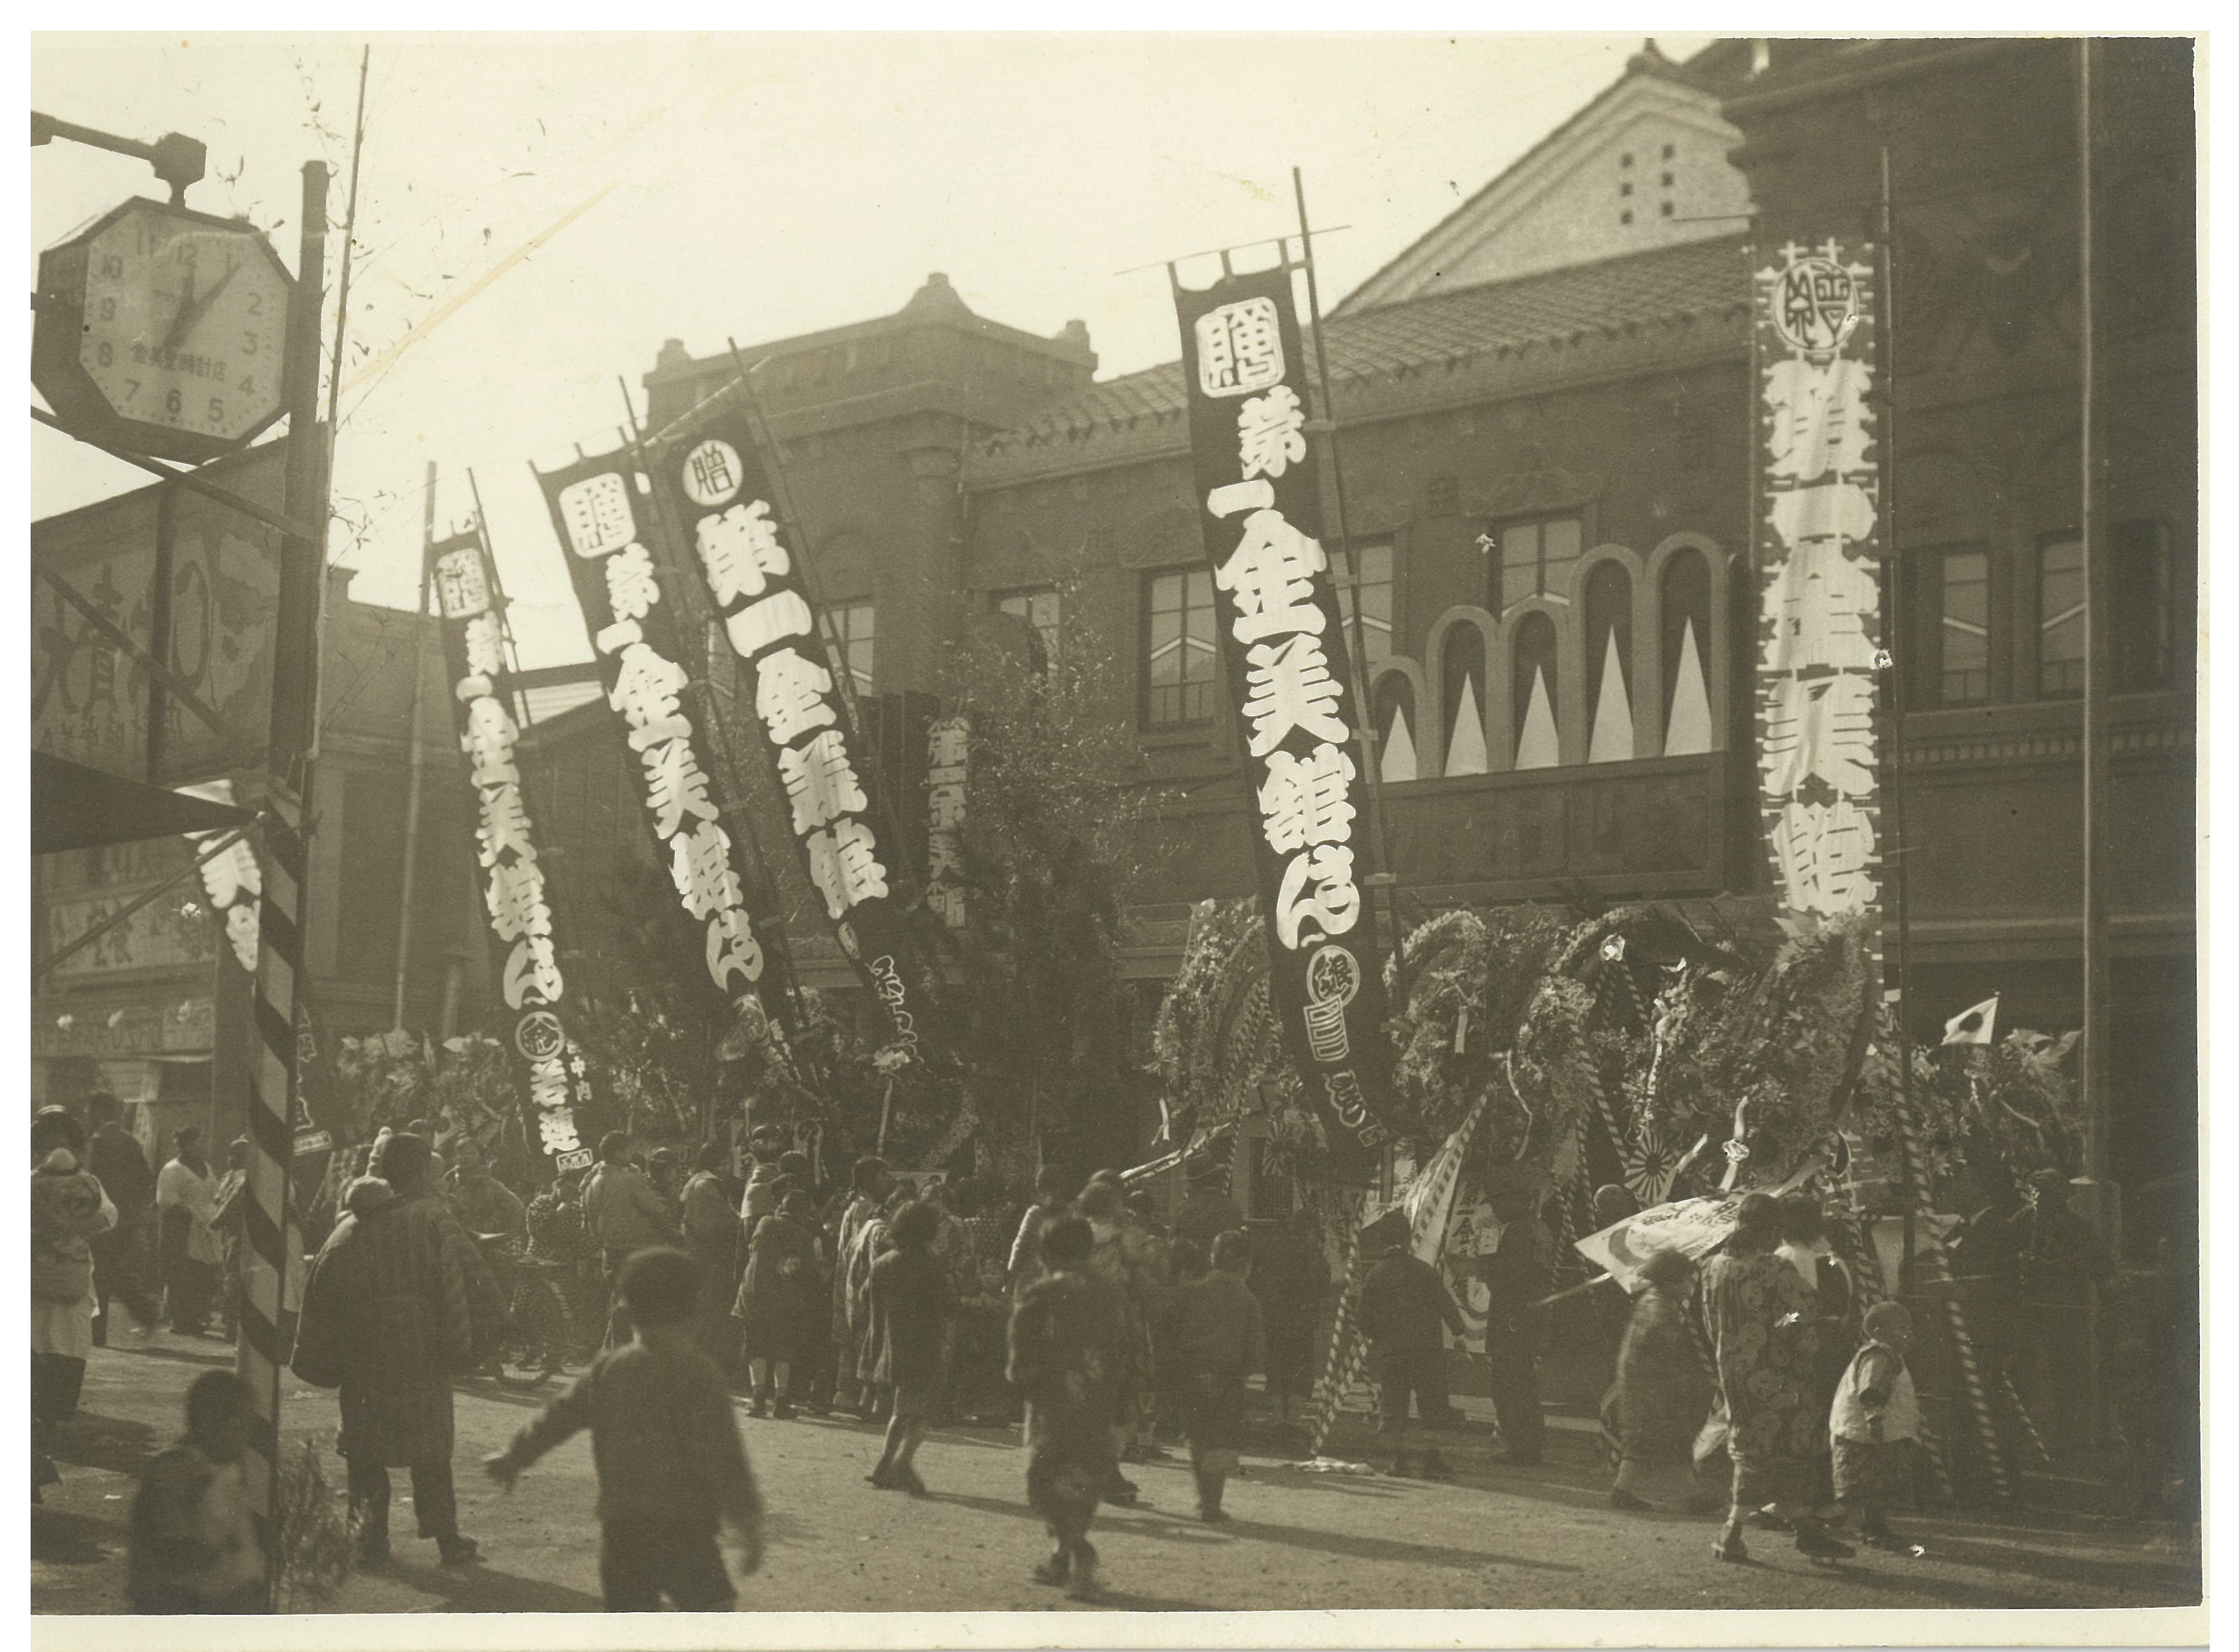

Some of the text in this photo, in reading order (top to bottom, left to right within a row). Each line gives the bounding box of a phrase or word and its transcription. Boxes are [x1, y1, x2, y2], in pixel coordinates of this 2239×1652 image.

[101, 253, 123, 280] 10
[100, 296, 117, 321] 9
[247, 291, 263, 316] 2
[97, 340, 114, 368] 8
[242, 330, 258, 355] 3
[123, 378, 142, 402] 7
[237, 374, 256, 397] 4
[166, 388, 183, 414] 6
[207, 397, 225, 424] 5
[688, 441, 739, 501] 贈
